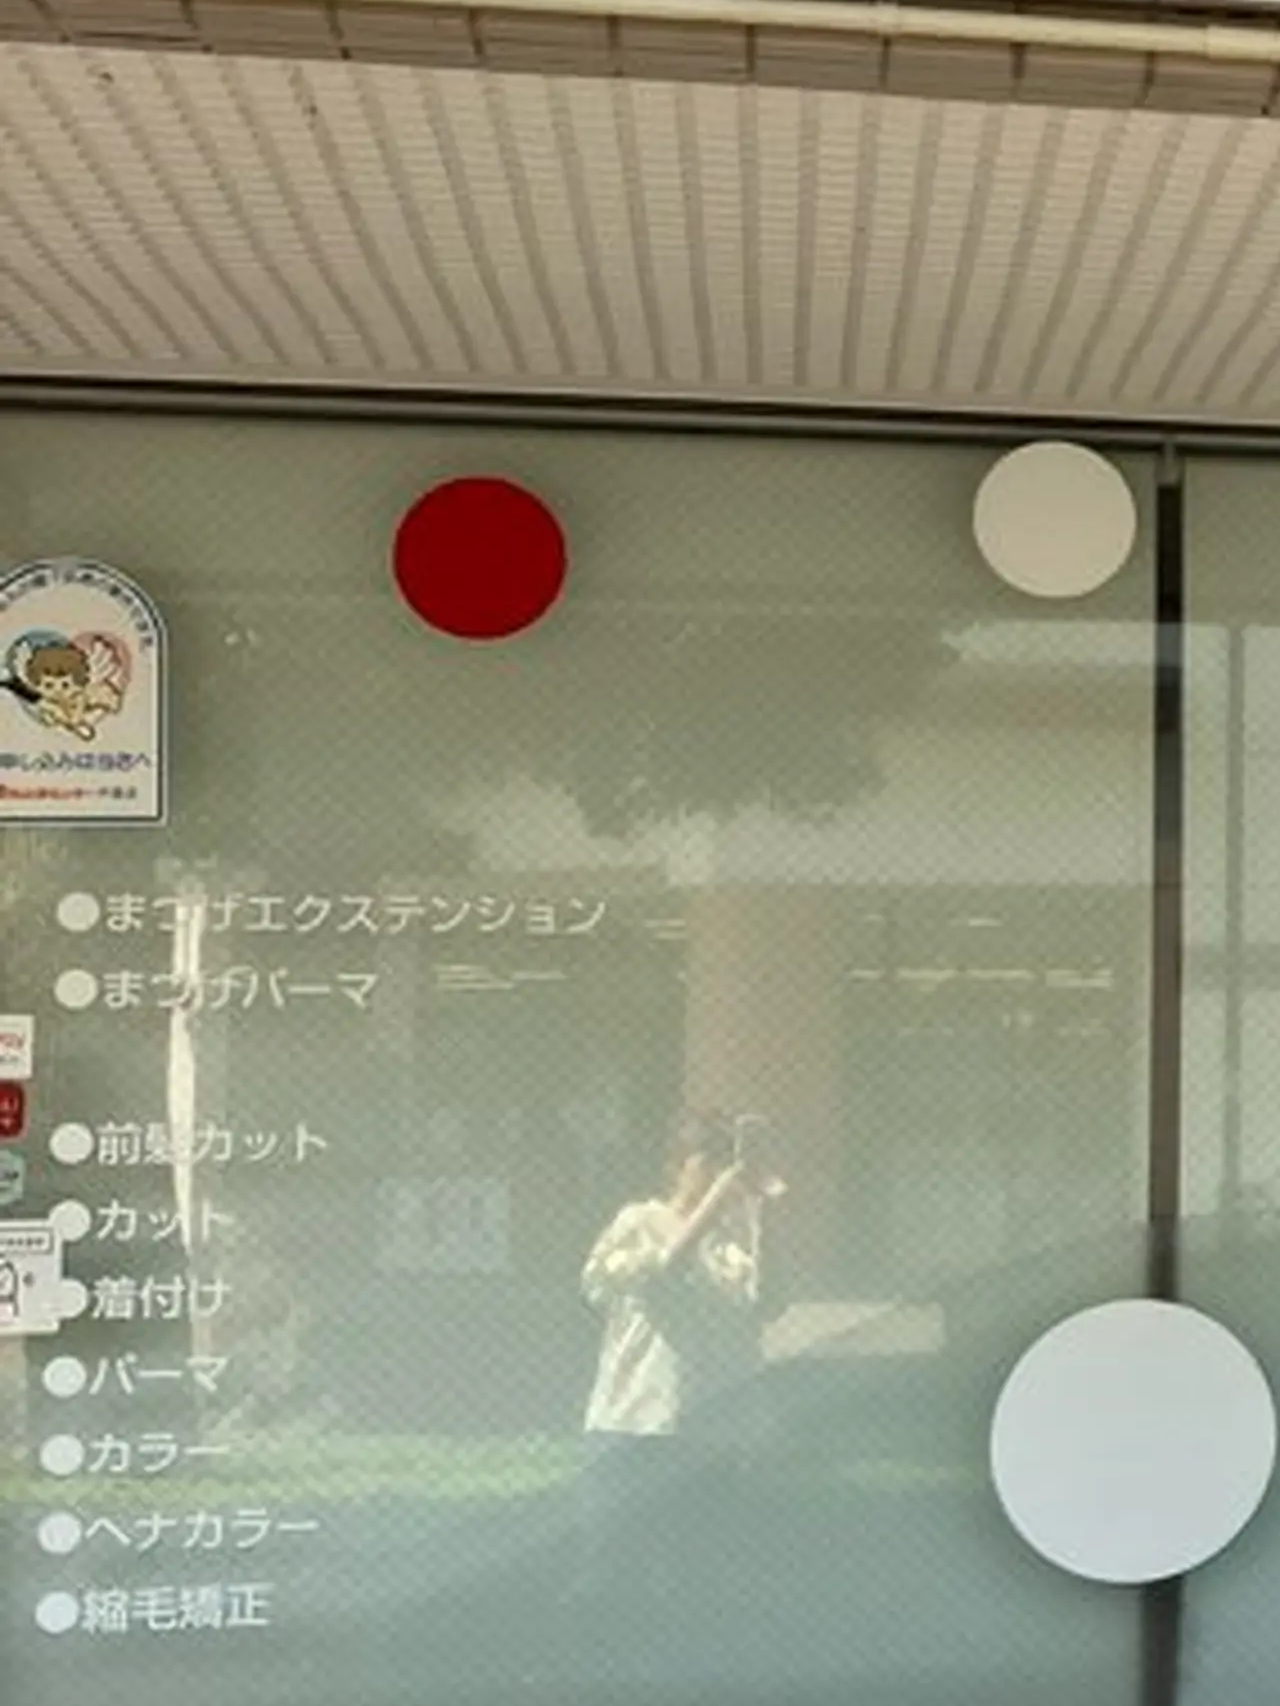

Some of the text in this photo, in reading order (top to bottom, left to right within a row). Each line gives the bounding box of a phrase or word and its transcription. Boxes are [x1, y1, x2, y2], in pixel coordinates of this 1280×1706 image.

[96, 1198, 236, 1241] カット
[91, 1274, 233, 1320] 着付け
[87, 1432, 231, 1474] カラー
[84, 1507, 321, 1552] ヘナカラー
[80, 1580, 276, 1635] 縮毛矯正
